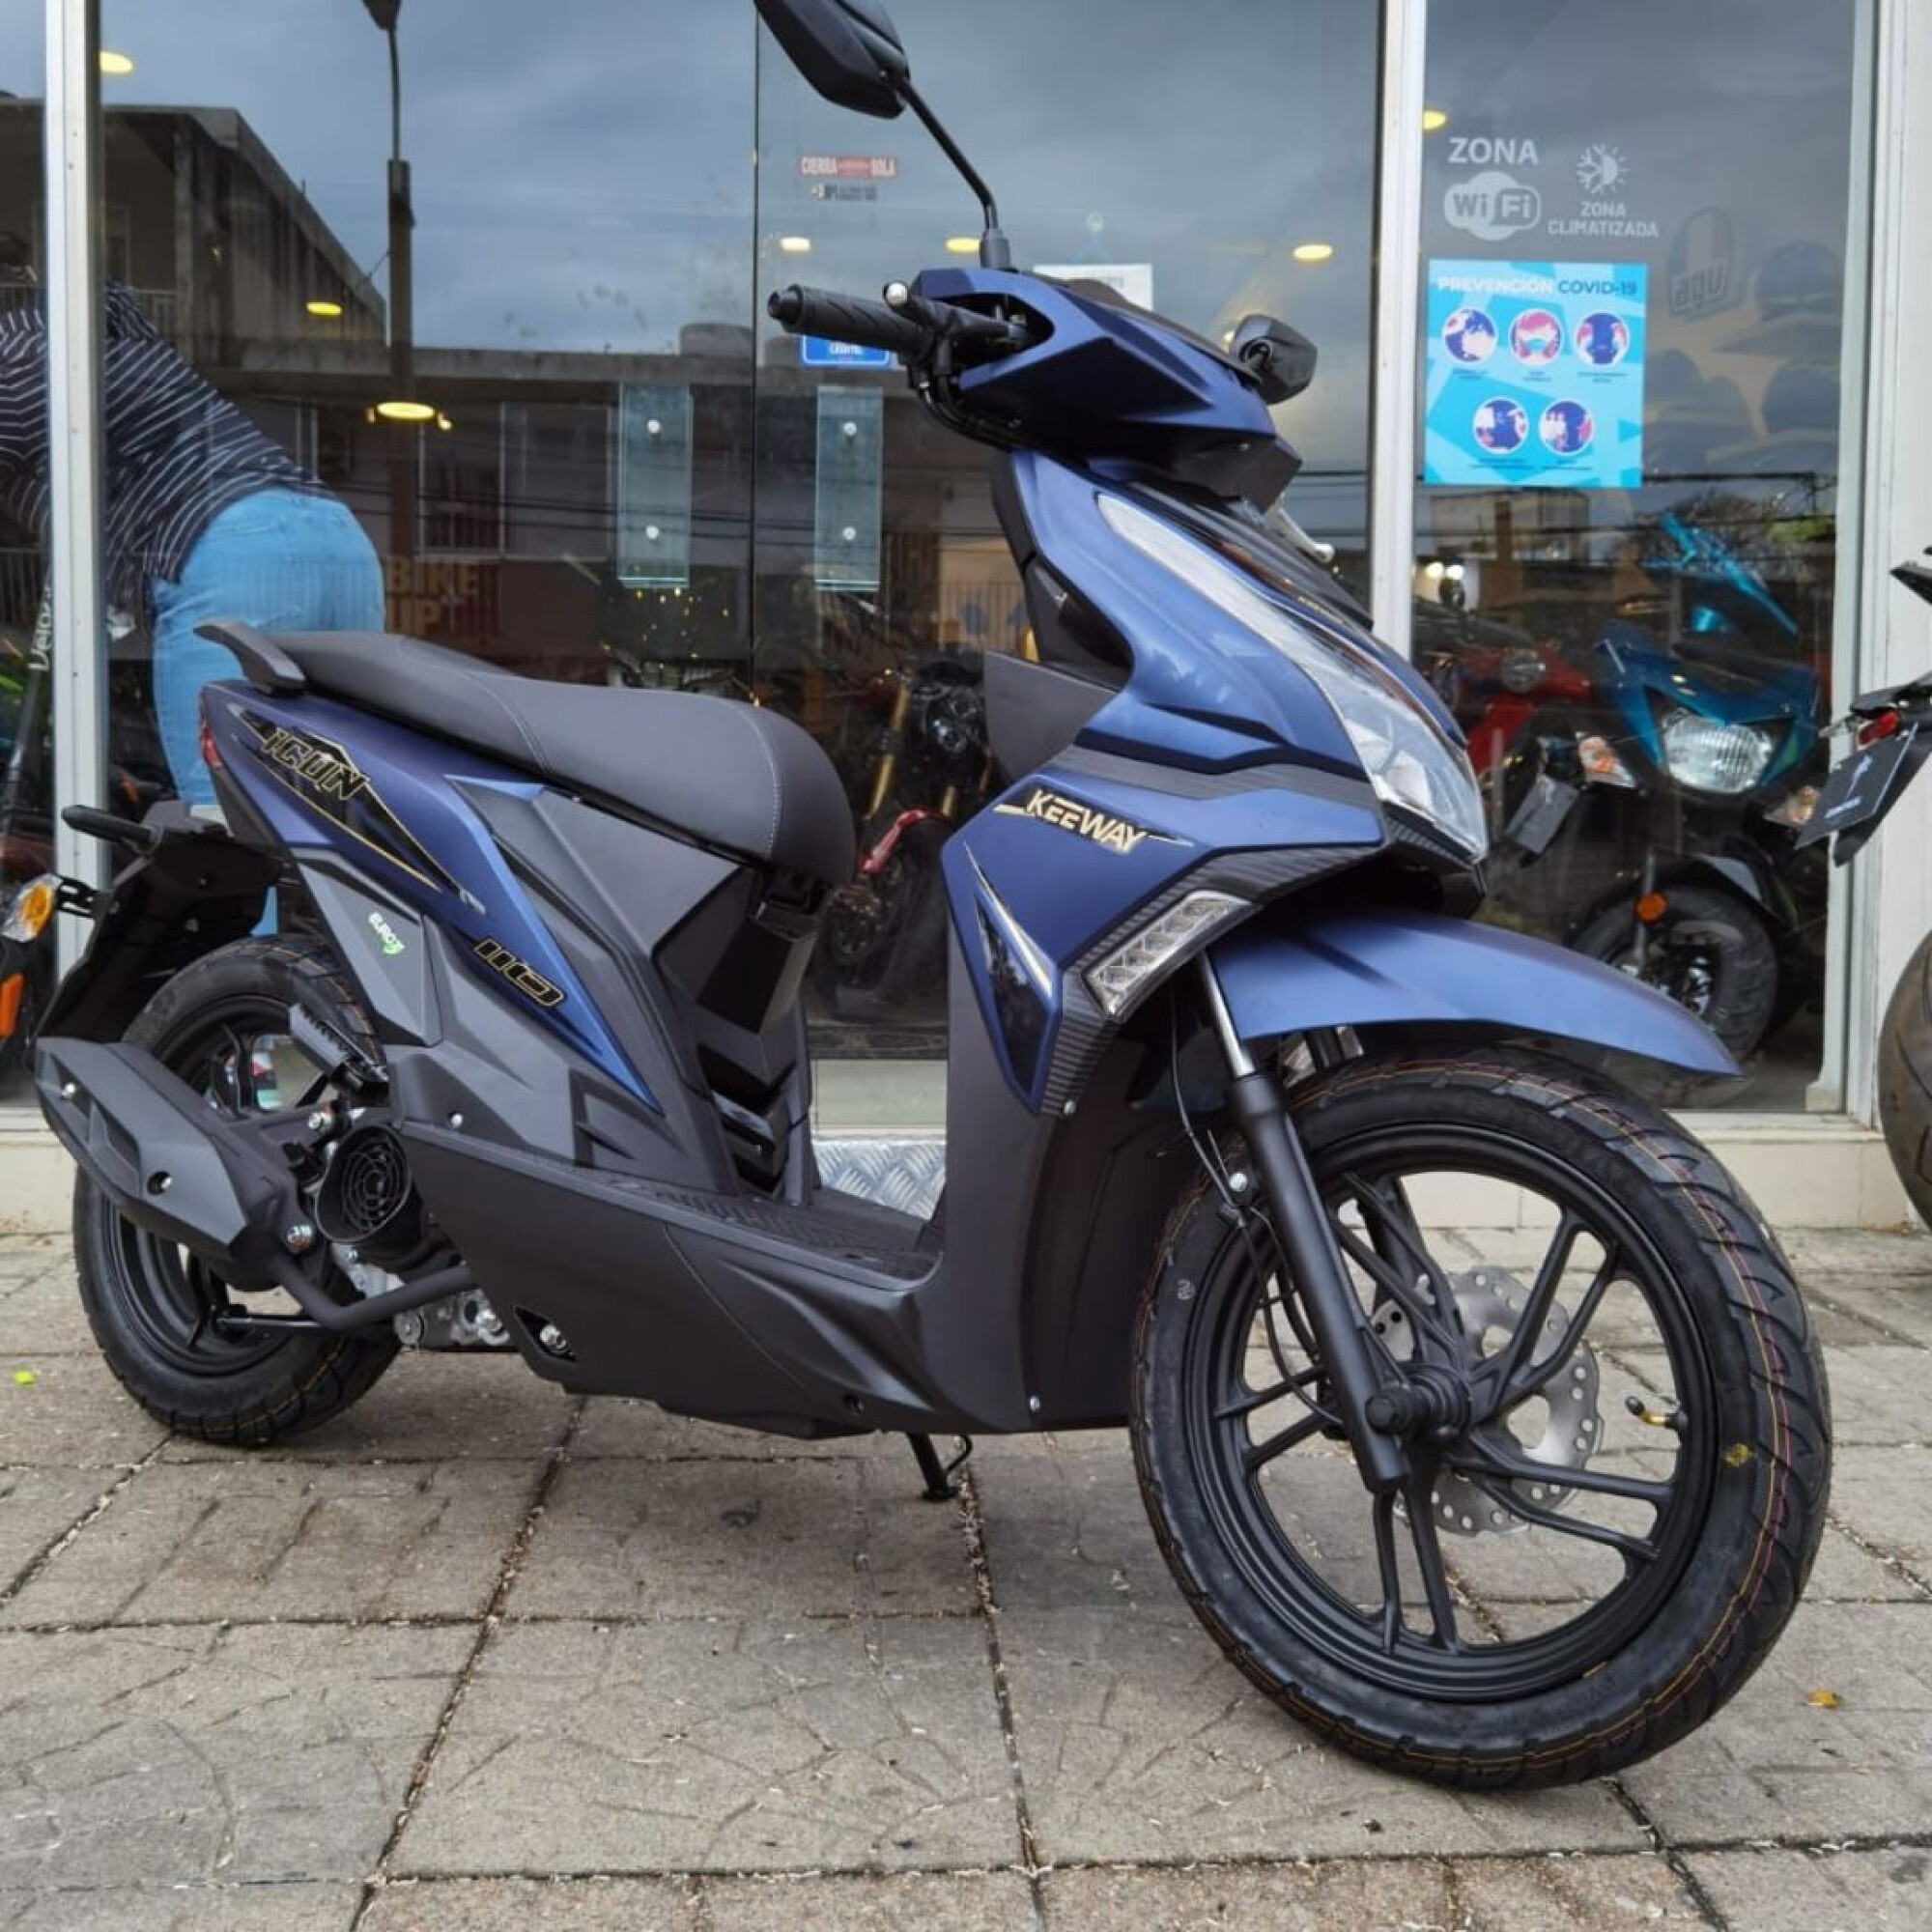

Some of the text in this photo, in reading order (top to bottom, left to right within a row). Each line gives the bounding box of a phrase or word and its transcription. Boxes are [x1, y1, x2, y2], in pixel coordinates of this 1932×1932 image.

[1449, 138, 1539, 164] ZONA
[1580, 202, 1626, 218] ZONA
[1548, 220, 1660, 239] CLIMATIZADA
[1558, 279, 1637, 297] COVID-19
[259, 727, 369, 801] ICON
[1026, 787, 1148, 854] KEEWAY
